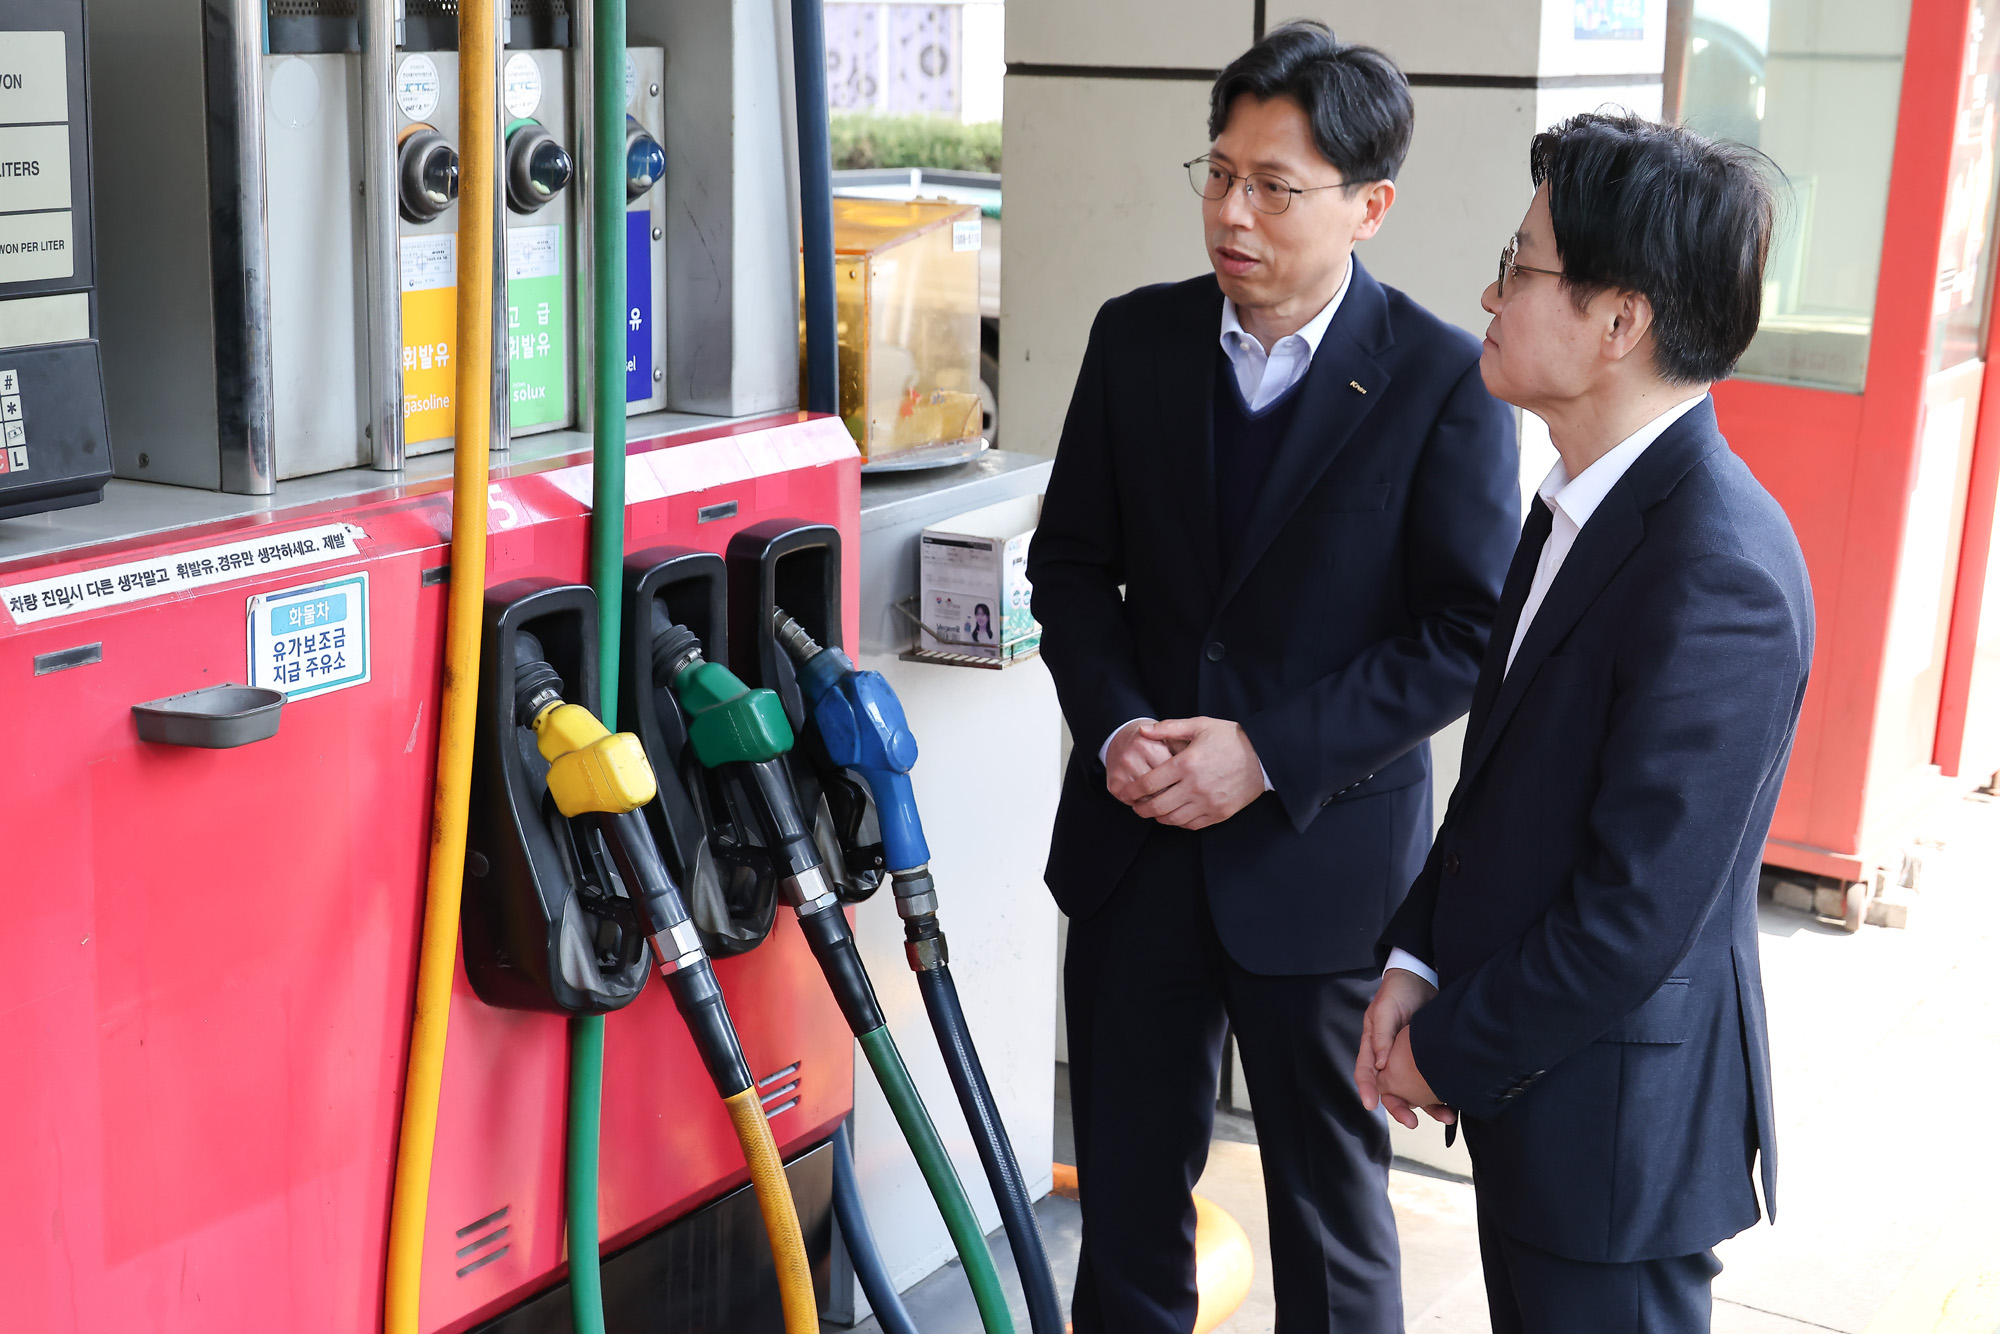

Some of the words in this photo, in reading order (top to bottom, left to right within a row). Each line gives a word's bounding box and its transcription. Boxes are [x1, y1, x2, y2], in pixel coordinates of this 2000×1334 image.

[0, 160, 40, 178] ITERS
[21, 241, 39, 253] PER
[40, 239, 65, 252] LITER
[403, 342, 450, 372] 휘발유
[403, 394, 450, 418] gasoline
[512, 384, 546, 403] solux
[13, 451, 24, 467] L
[487, 483, 519, 529] 5
[9, 592, 38, 614] 차량
[41, 584, 84, 608] 진입시
[86, 578, 114, 598] 다른
[117, 567, 170, 593] 생각말고
[176, 551, 254, 579] 휘발유,경유만
[257, 539, 320, 564] 생각하세요.
[322, 532, 346, 550] 제발
[288, 600, 330, 627] 화물차
[272, 627, 346, 663] 유가보조금
[273, 661, 301, 685] 지급
[305, 651, 346, 678] 주유소
